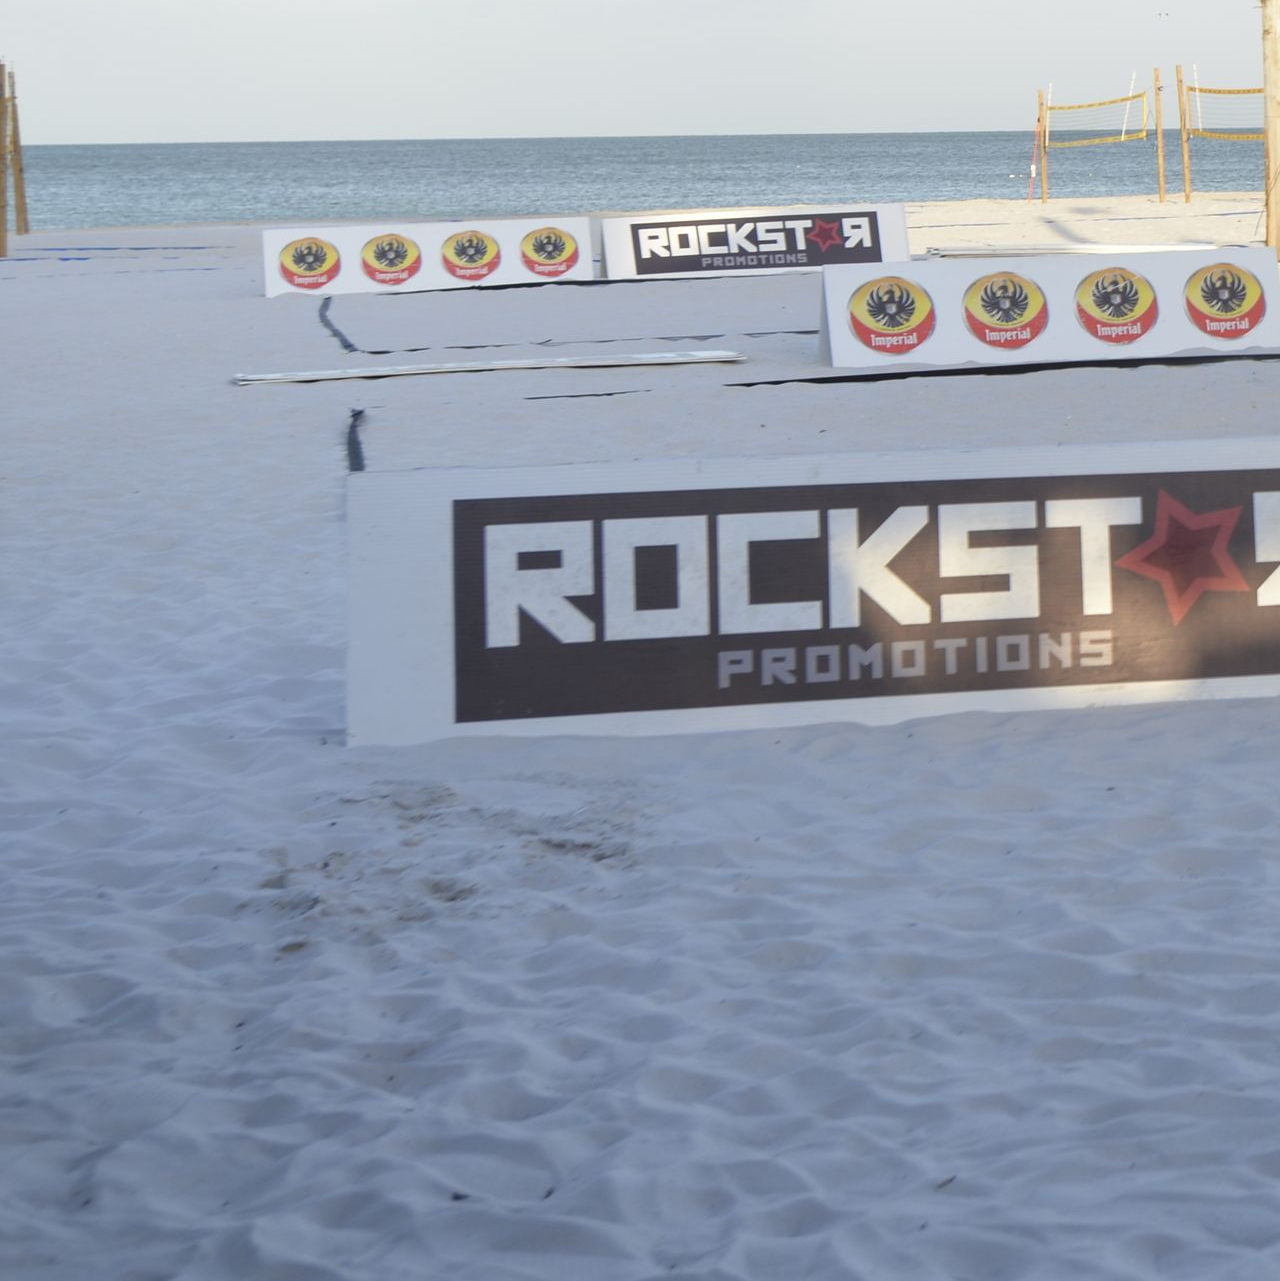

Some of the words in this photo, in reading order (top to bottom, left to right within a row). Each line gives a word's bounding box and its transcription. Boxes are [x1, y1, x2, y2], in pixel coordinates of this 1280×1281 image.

[534, 262, 567, 273] Imperial
[702, 253, 808, 267] PROMOTIONS
[375, 270, 409, 282] Imperial
[455, 266, 488, 277] Imperial
[294, 274, 327, 286] Imperial
[1096, 321, 1142, 340] Imperial
[1205, 316, 1250, 335] Imperial
[870, 331, 918, 348] Imperial
[984, 326, 1031, 345] Imperial
[717, 630, 1115, 690] PROMOTIONS
